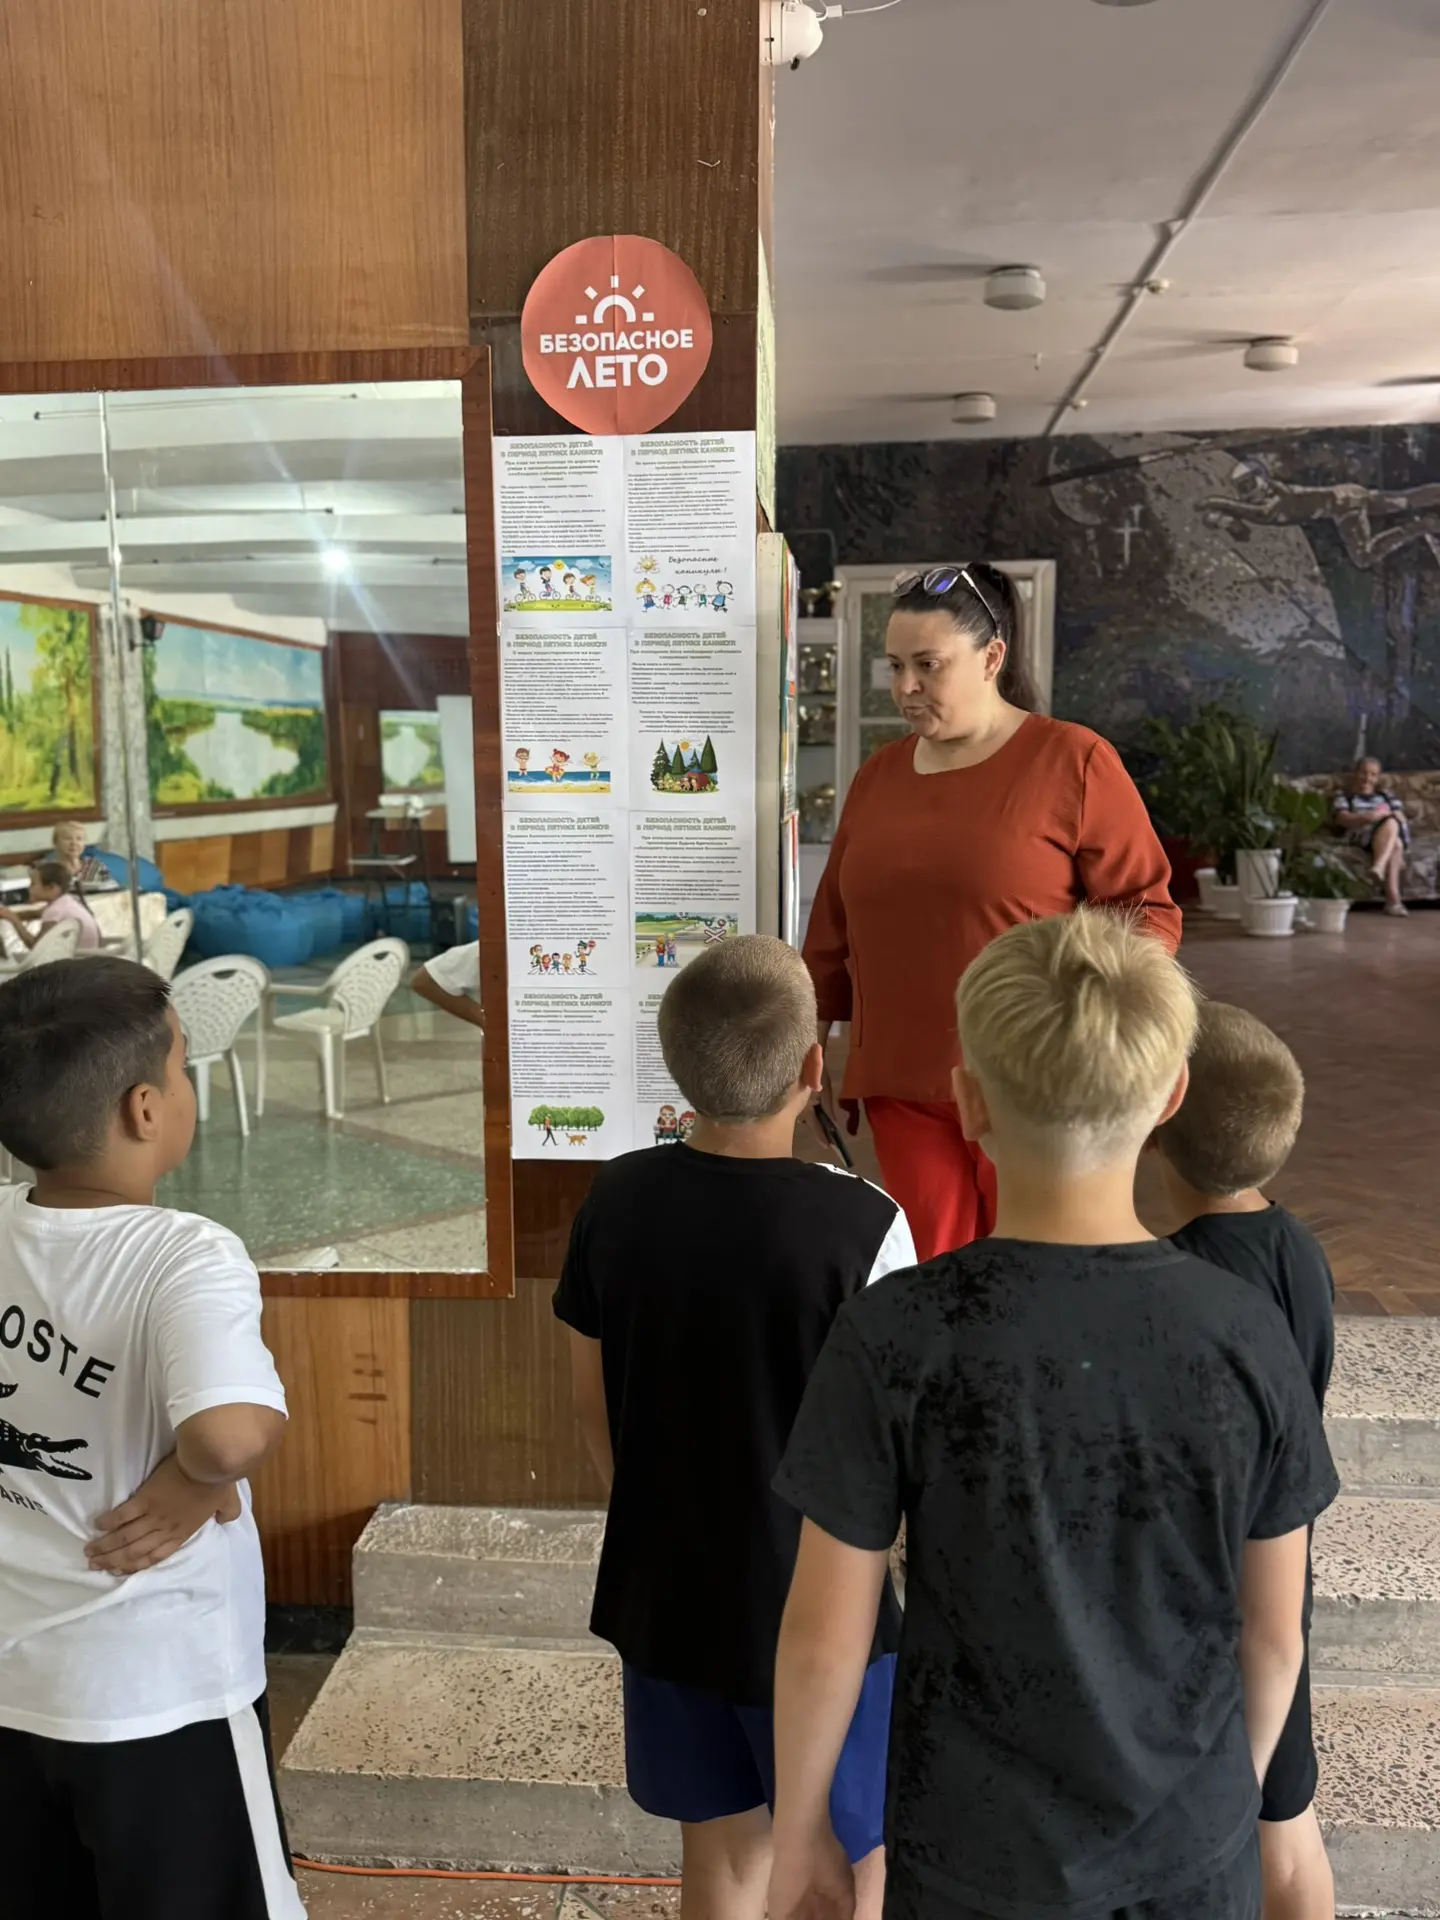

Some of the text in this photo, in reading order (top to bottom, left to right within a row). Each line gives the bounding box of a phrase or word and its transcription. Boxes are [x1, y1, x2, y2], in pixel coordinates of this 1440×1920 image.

[539, 328, 694, 353] БЕЗОПАСНОЕ
[567, 353, 668, 389] ЛЕТО
[0, 1305, 115, 1398] OSTE
